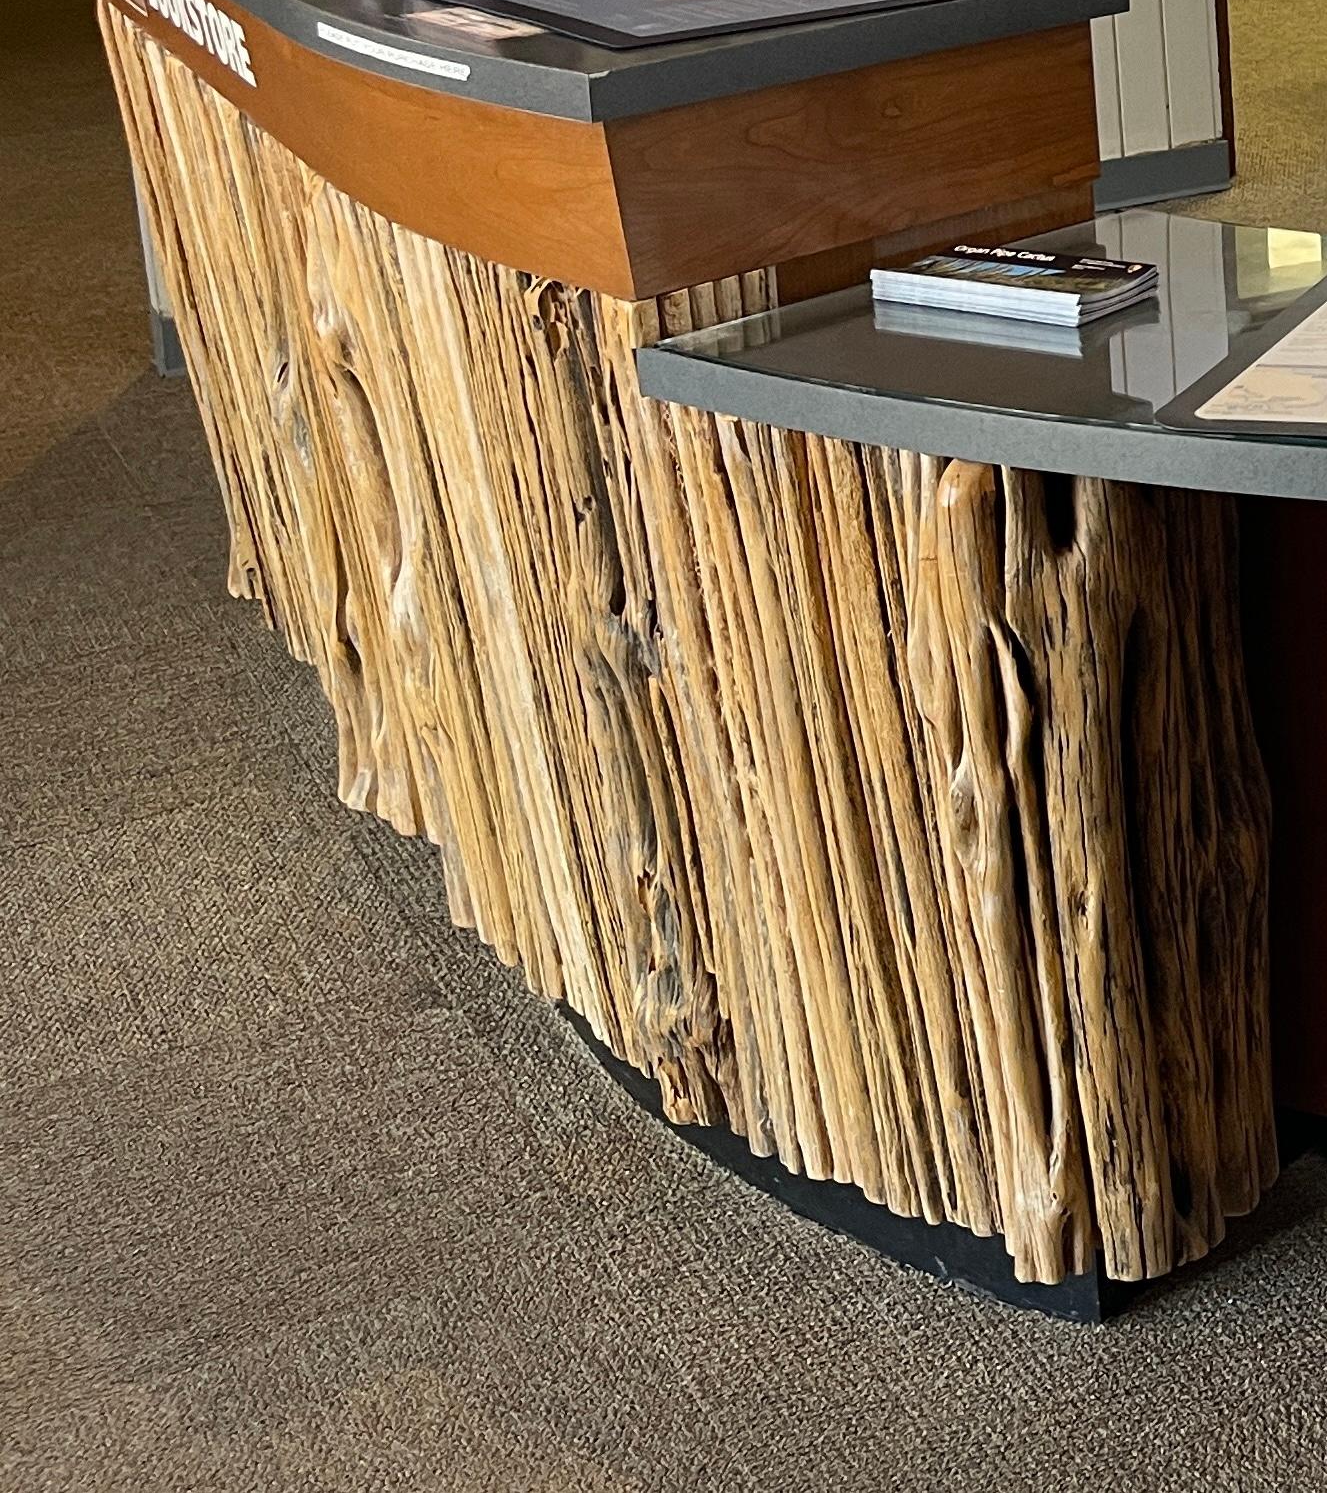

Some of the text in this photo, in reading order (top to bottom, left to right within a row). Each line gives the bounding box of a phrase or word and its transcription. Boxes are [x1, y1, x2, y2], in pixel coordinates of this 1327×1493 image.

[954, 245, 1056, 262] Organ Pipe Cactus
